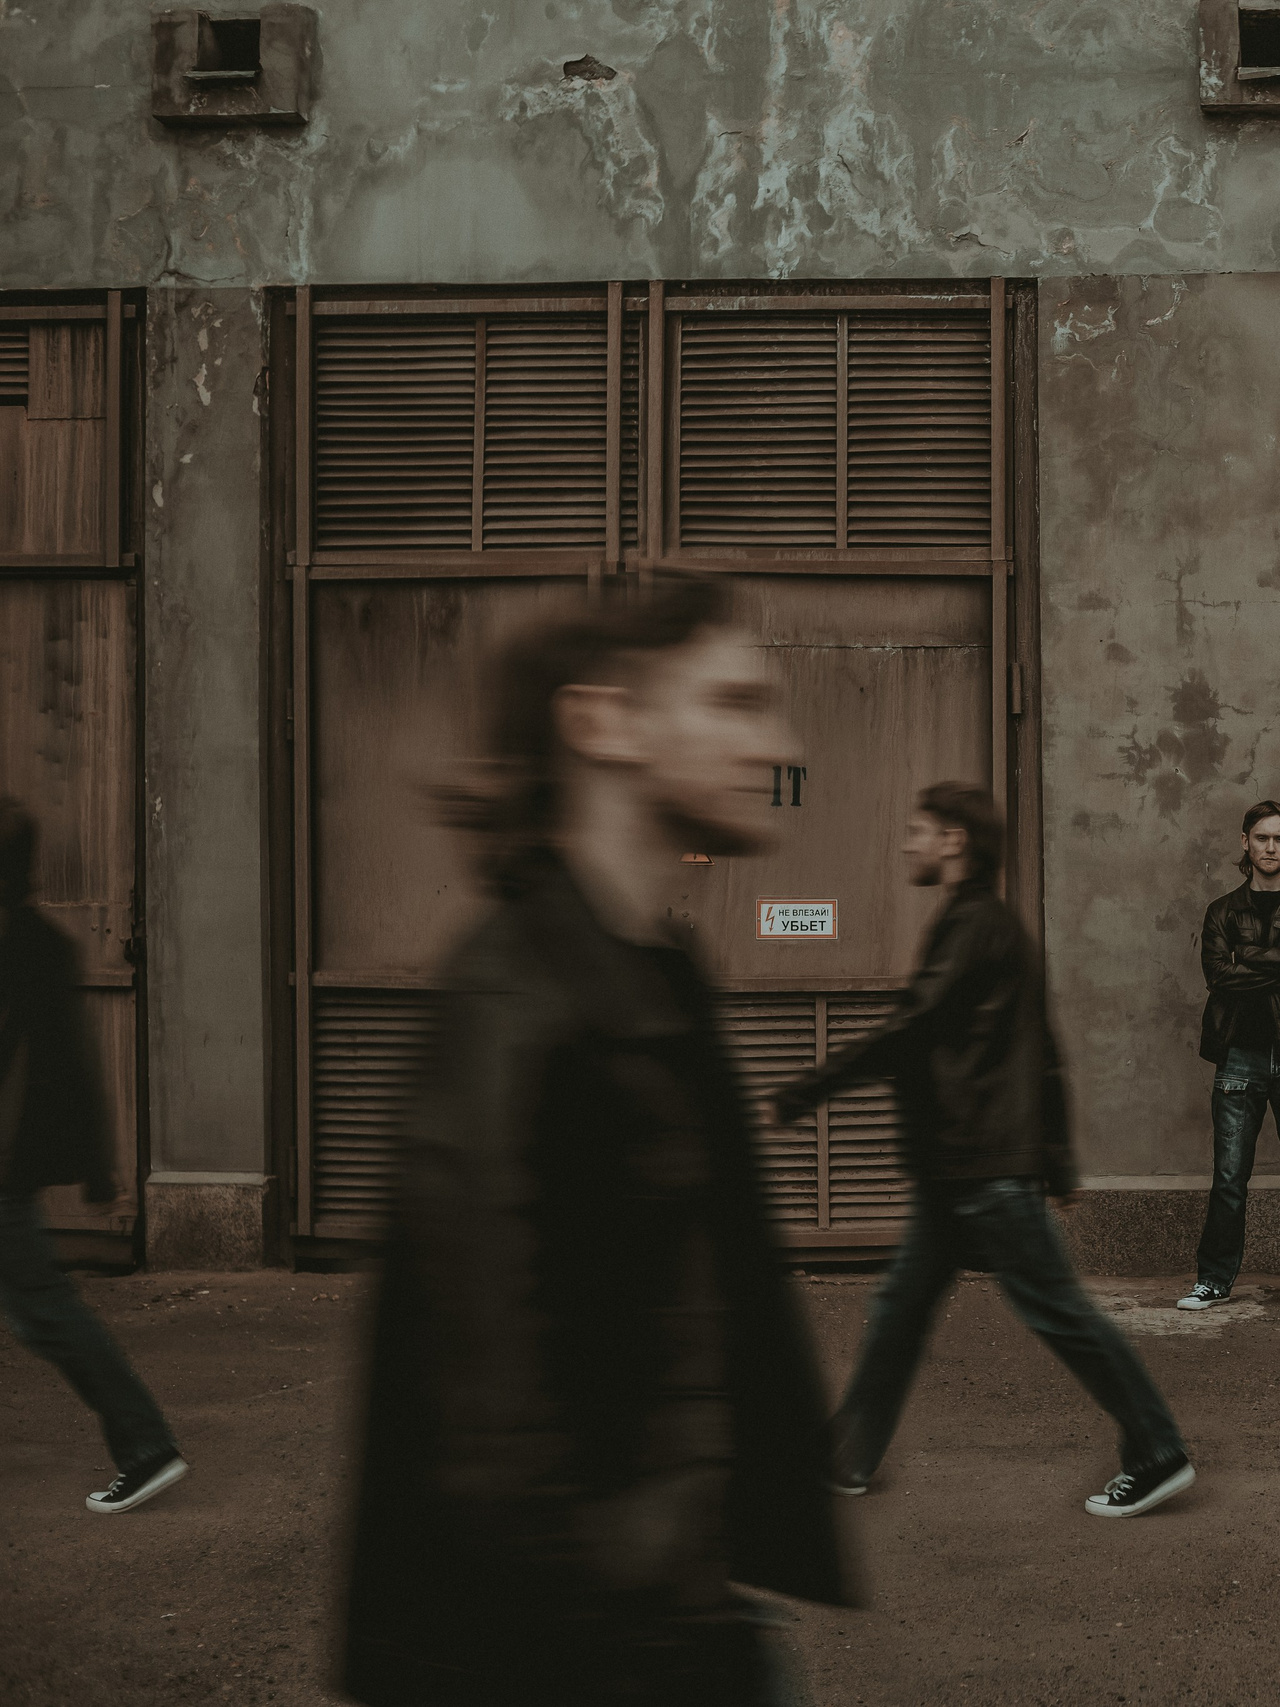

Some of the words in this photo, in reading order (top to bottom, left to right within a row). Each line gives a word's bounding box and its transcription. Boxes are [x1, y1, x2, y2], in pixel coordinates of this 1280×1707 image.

[778, 909, 790, 917] НЕ
[792, 908, 829, 917] ВЛЕЗАЙ!
[781, 920, 827, 932] УБЬЕТ
